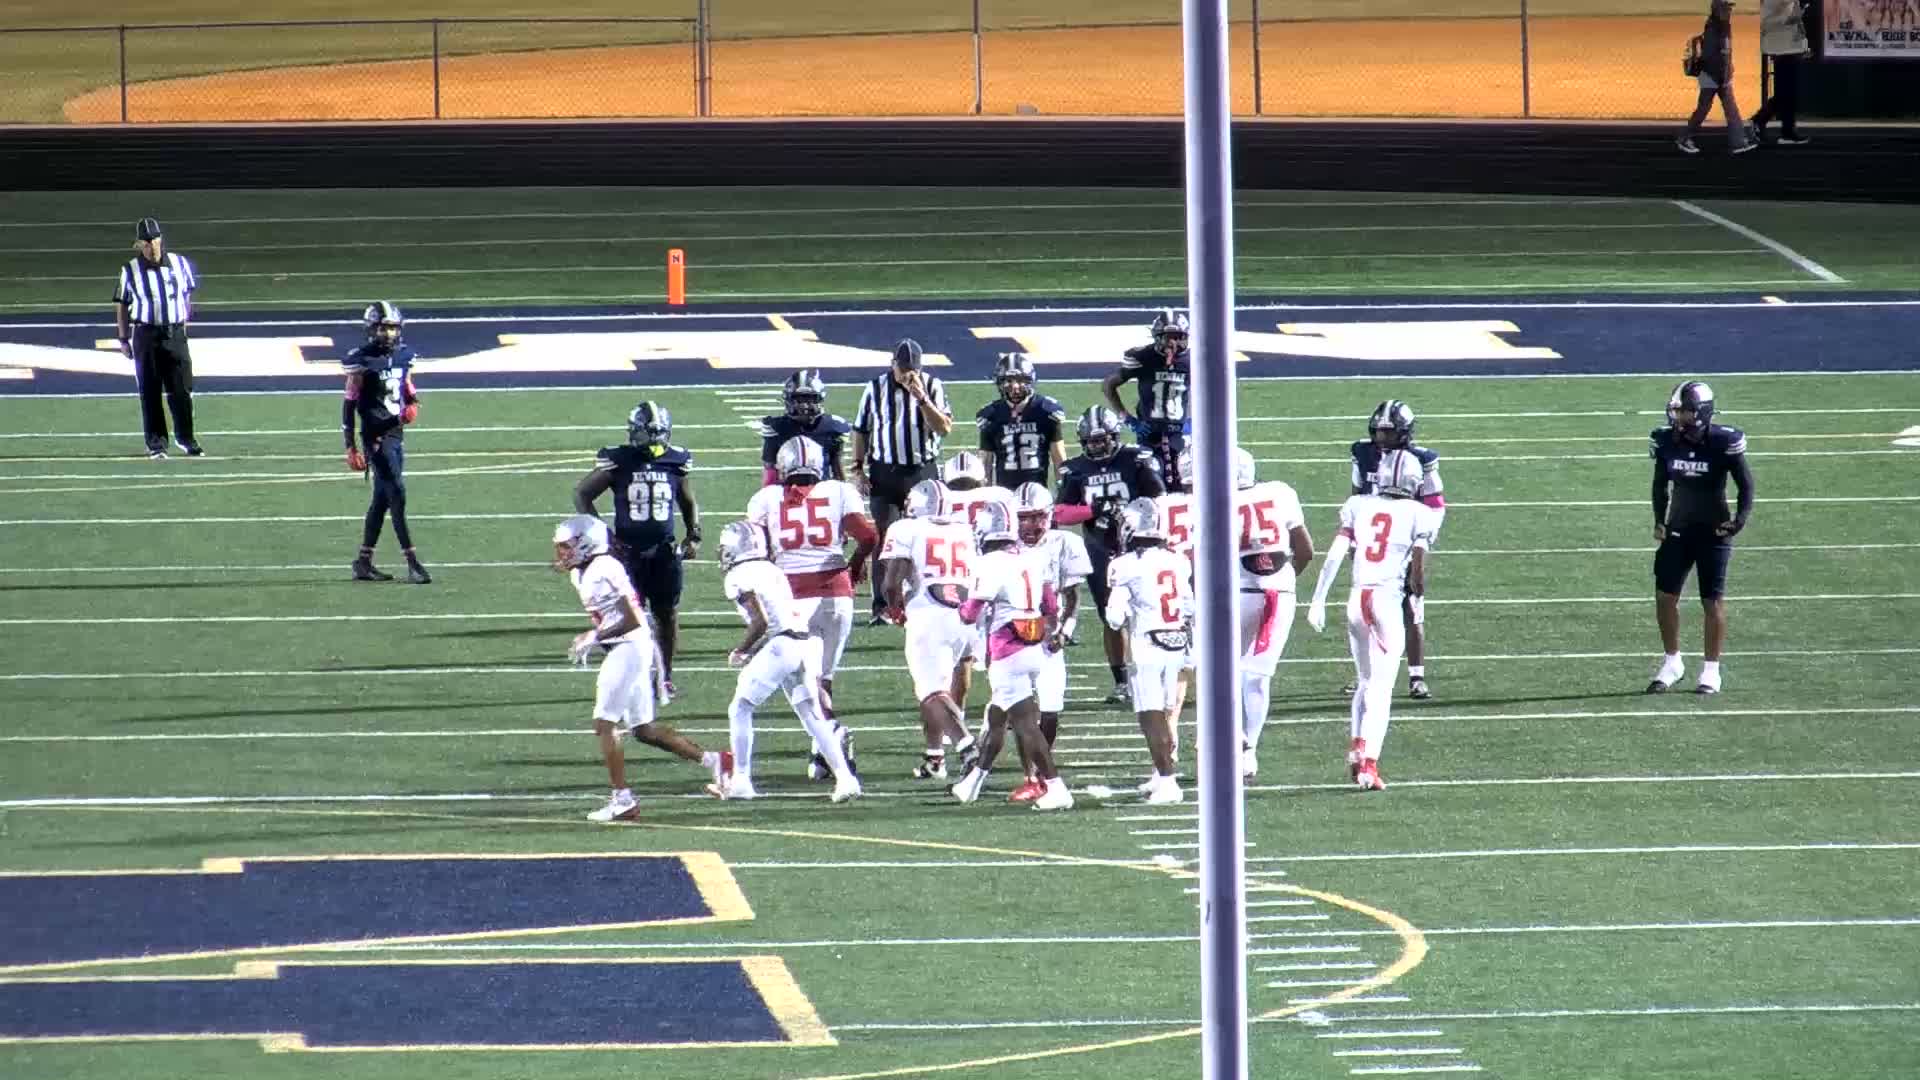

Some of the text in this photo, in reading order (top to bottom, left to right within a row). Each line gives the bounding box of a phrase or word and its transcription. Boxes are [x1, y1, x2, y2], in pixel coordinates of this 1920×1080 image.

[1001, 433, 1040, 470] 12
[779, 497, 833, 551] 55
[1365, 511, 1392, 562] 3
[924, 537, 968, 577] 56
[1021, 569, 1035, 612] 1
[1157, 570, 1181, 623] 2
